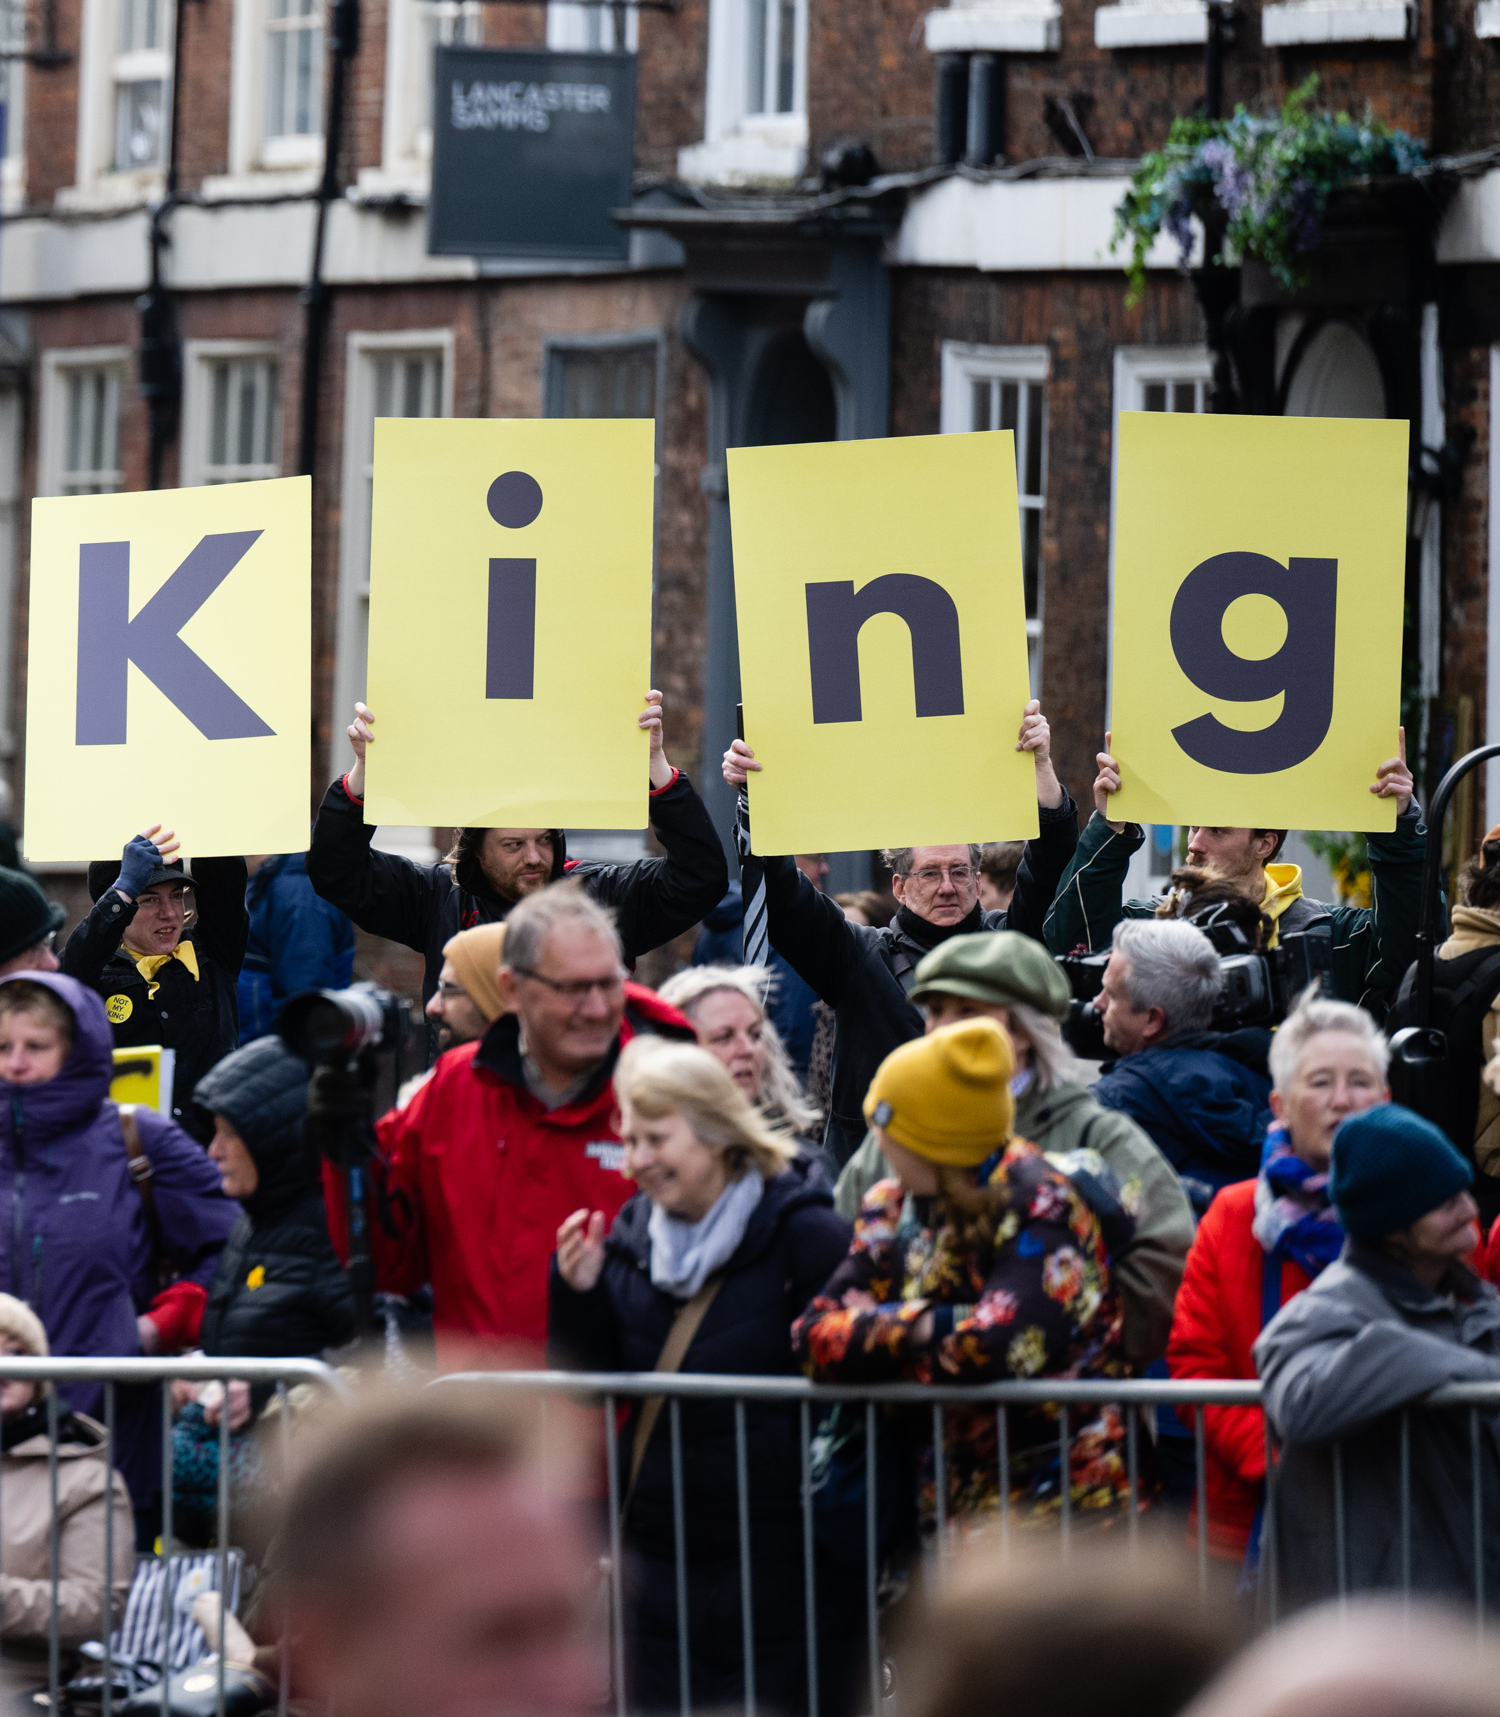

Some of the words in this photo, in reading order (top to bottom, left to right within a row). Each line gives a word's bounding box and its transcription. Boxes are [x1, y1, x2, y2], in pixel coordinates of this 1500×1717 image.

[452, 80, 611, 113] LANCASTER
[113, 996, 129, 1006] NOT
[112, 1003, 124, 1012] MY
[107, 1009, 125, 1021] KING
